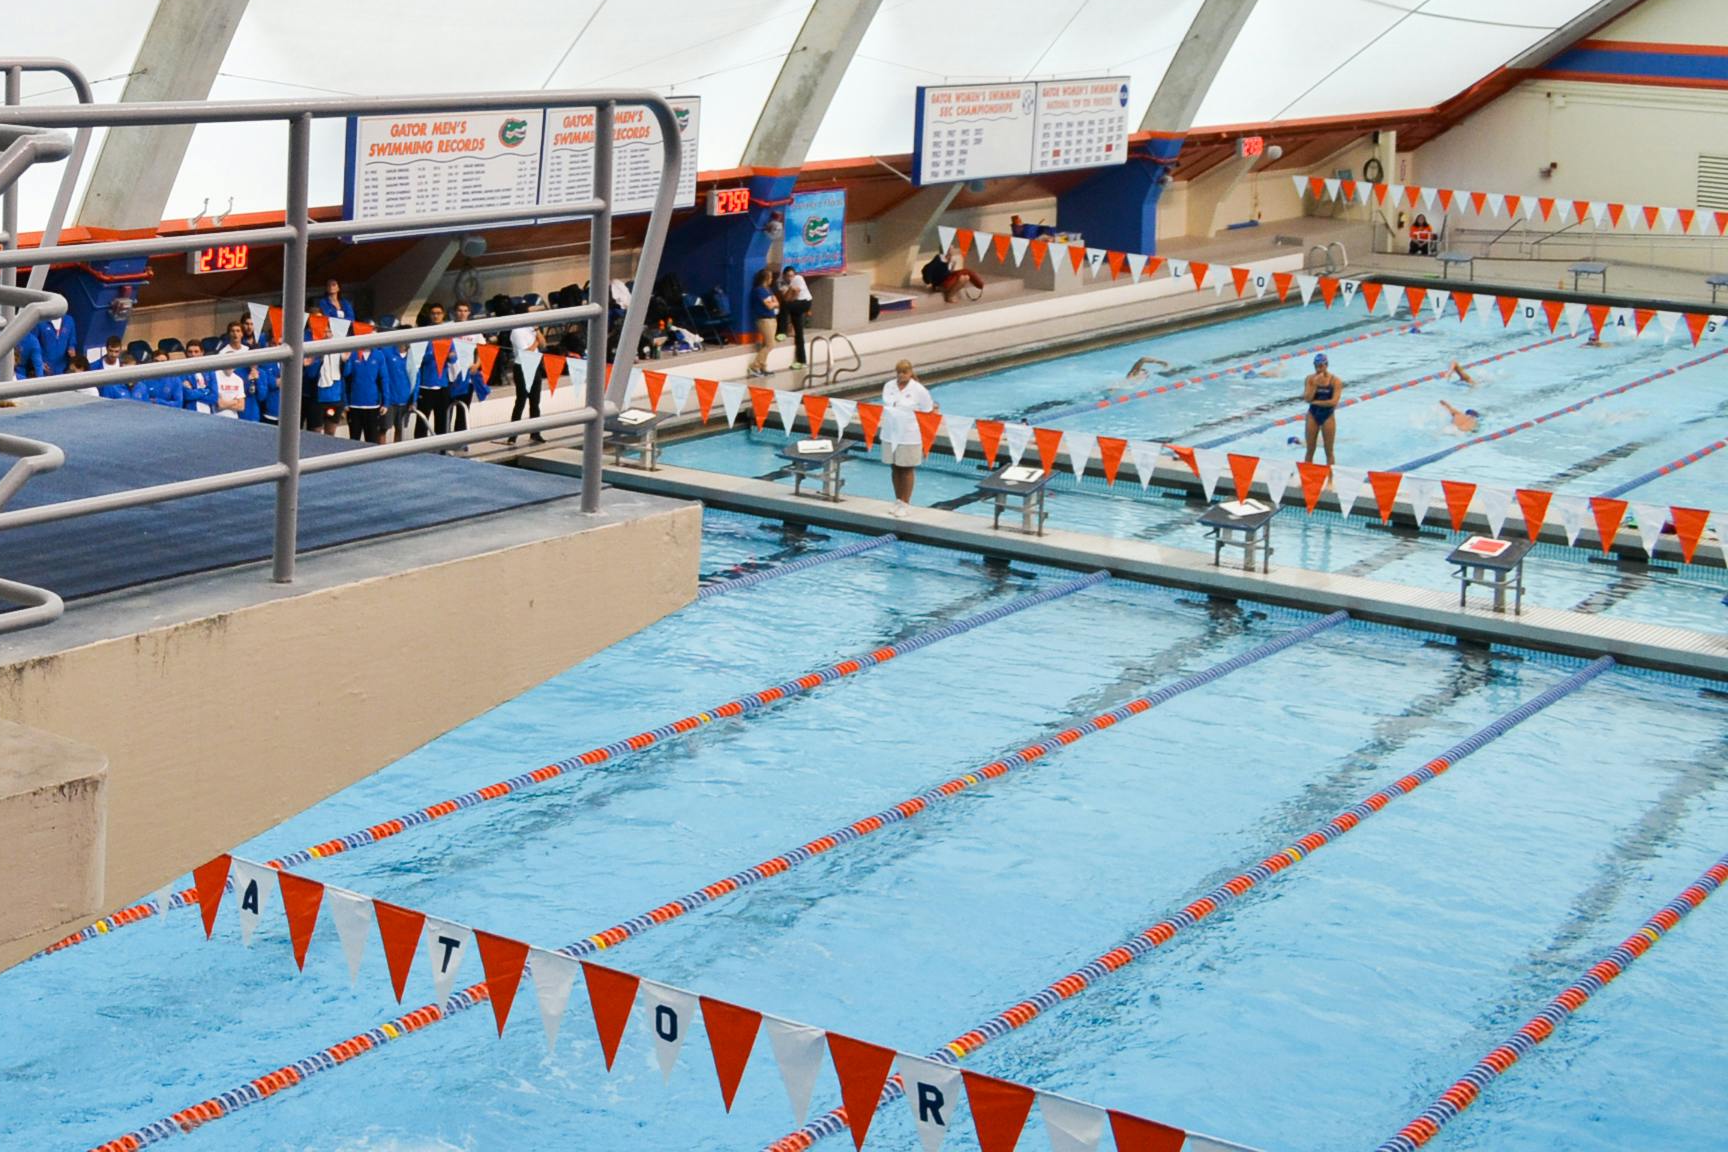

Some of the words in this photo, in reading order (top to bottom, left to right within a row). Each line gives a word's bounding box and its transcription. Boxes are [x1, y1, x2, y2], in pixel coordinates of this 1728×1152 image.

[390, 123, 427, 138] GATOR
[432, 121, 467, 136] MEN'S
[563, 114, 593, 128] GATOR
[614, 110, 644, 124] MEN'S
[368, 140, 433, 158] SWIMMING
[437, 138, 485, 154] RECORDS
[241, 879, 259, 915] A
[438, 935, 461, 974] T
[655, 1004, 678, 1043] O
[916, 1081, 946, 1126] R
